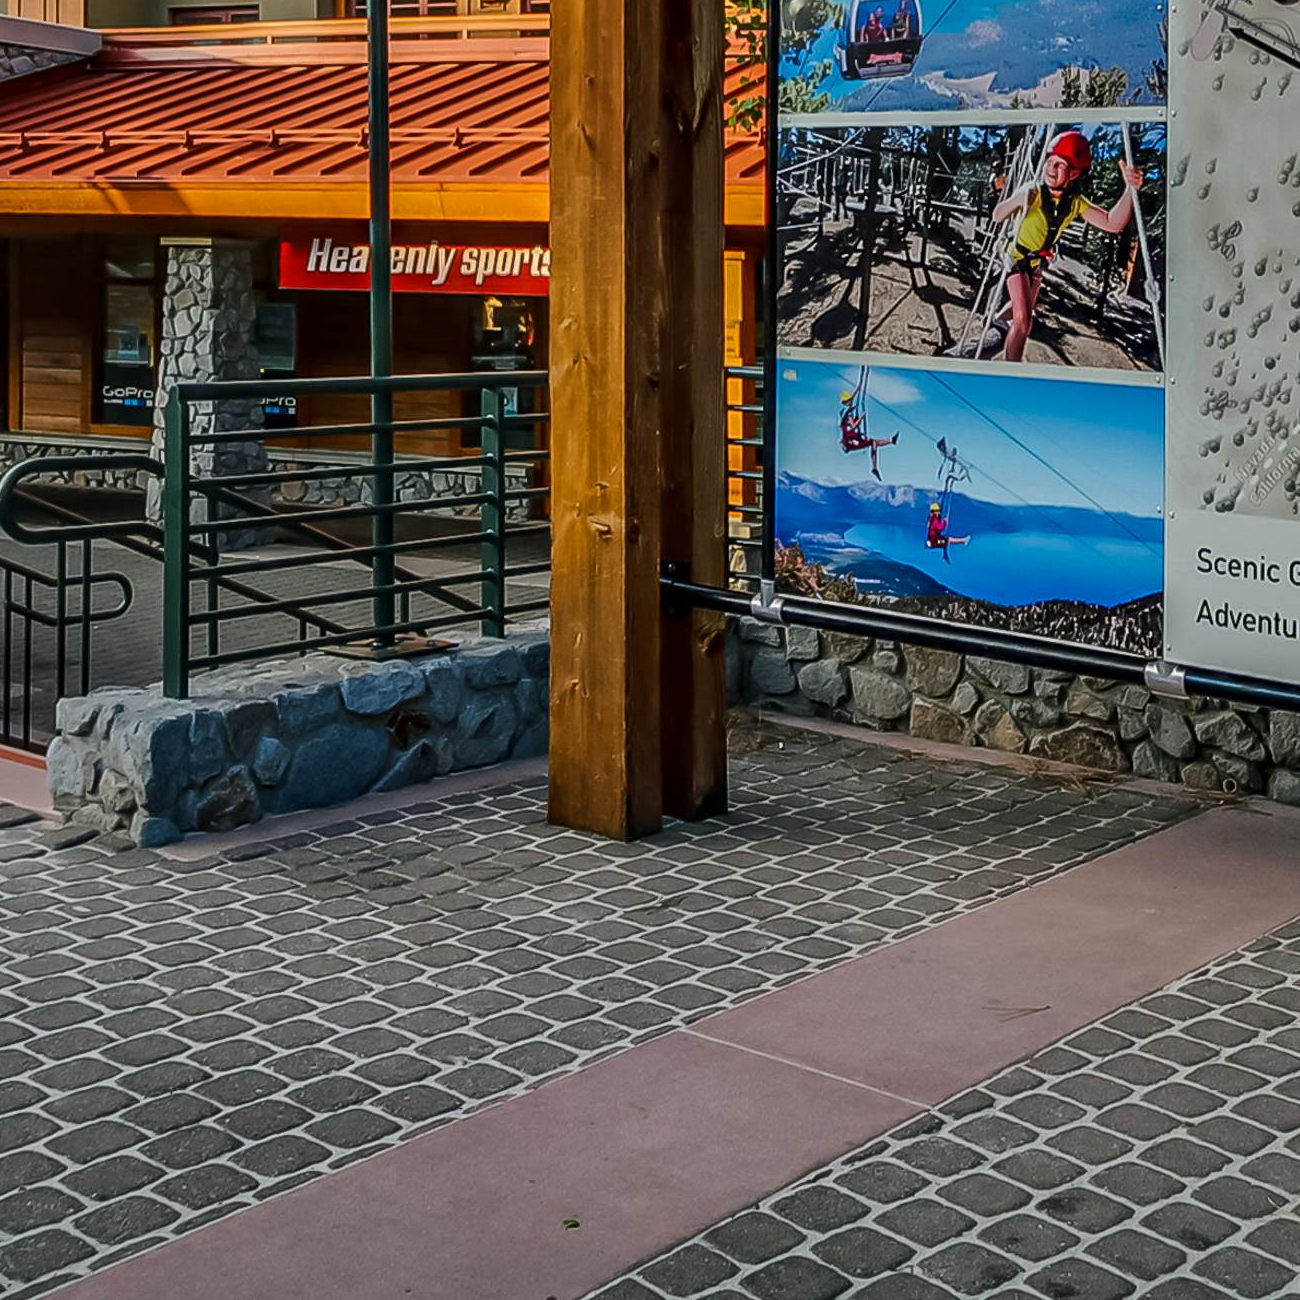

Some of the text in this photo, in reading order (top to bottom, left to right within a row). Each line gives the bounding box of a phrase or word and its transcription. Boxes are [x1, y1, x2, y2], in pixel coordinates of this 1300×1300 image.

[307, 238, 455, 285] Heaenly
[102, 385, 154, 398] GoPro
[1197, 547, 1281, 583] Scenic
